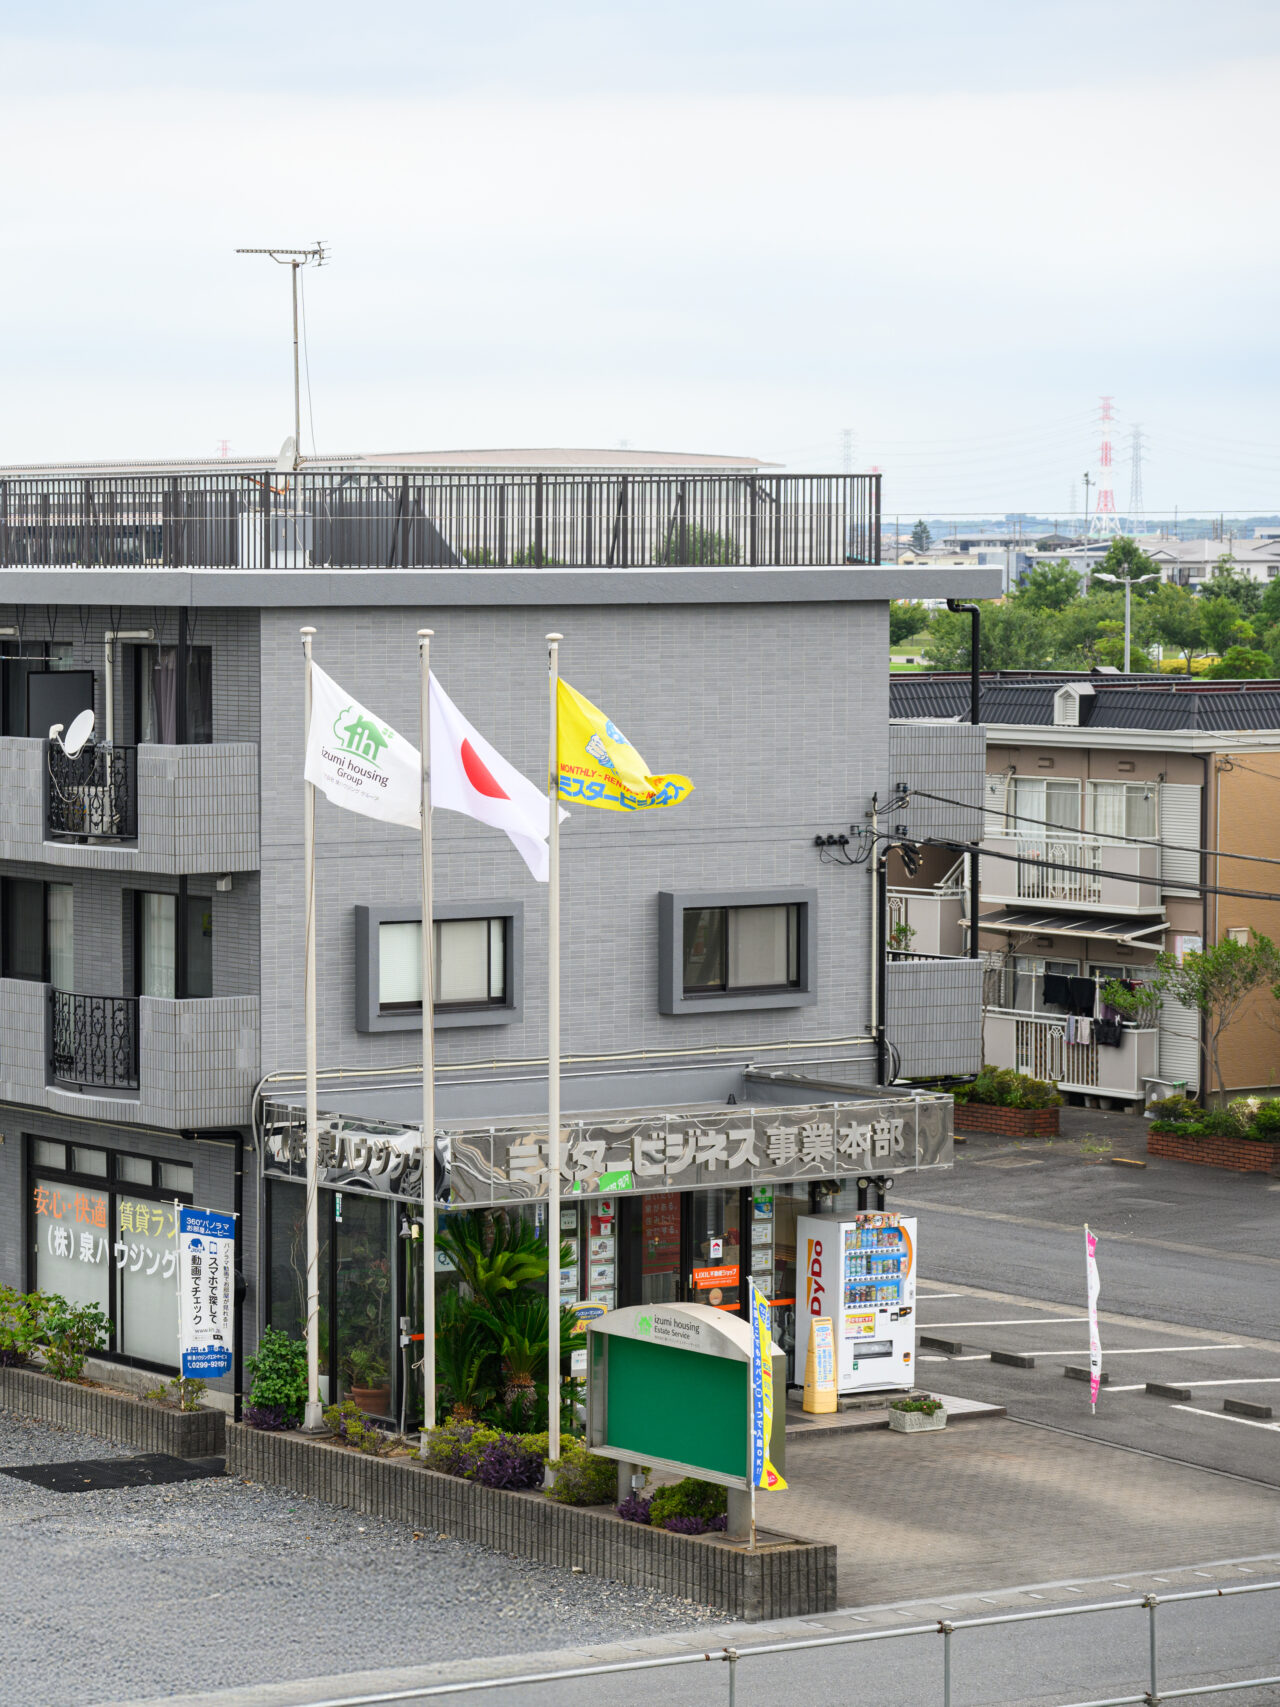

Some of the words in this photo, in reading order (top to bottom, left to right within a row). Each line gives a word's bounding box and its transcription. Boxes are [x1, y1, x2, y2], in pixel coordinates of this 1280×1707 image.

[321, 746, 346, 767] izumi
[347, 759, 389, 788] housing
[337, 767, 363, 786] Group
[560, 763, 597, 778] MONTHLY
[33, 1185, 107, 1229] 安心・快適
[191, 1255, 202, 1326] 動画でチェック
[208, 1257, 219, 1325] スマホで探して
[810, 1240, 825, 1317] DyDo
[654, 1314, 672, 1327] izumi
[673, 1318, 700, 1335] housing
[654, 1326, 671, 1336] Estate
[671, 1329, 691, 1340] Service
